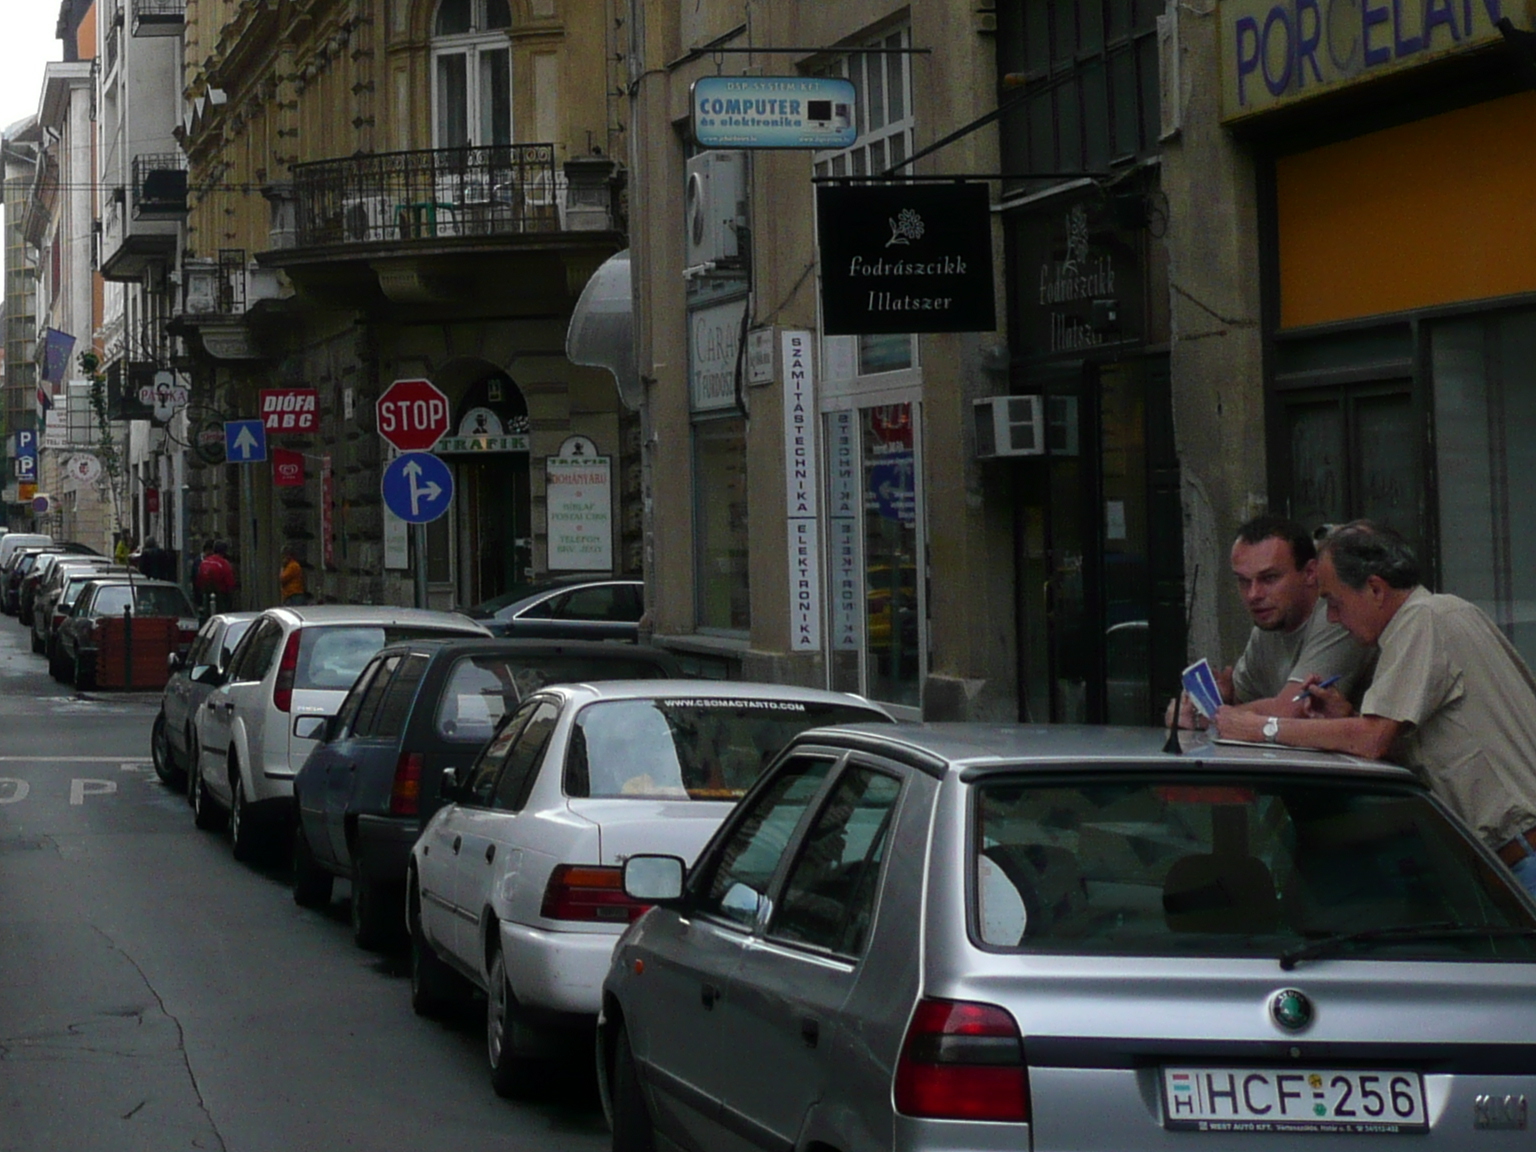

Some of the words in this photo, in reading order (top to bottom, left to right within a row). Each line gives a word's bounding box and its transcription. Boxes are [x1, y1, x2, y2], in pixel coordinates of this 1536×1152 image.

[700, 98, 801, 115] COMPUTER
[720, 116, 802, 127] elektronika
[868, 290, 953, 311] Illatszer
[263, 392, 315, 412] DIÓFA
[381, 399, 444, 431] STOP
[439, 435, 526, 450] TRAFIK
[797, 524, 811, 645] ELEKTRONIKA
